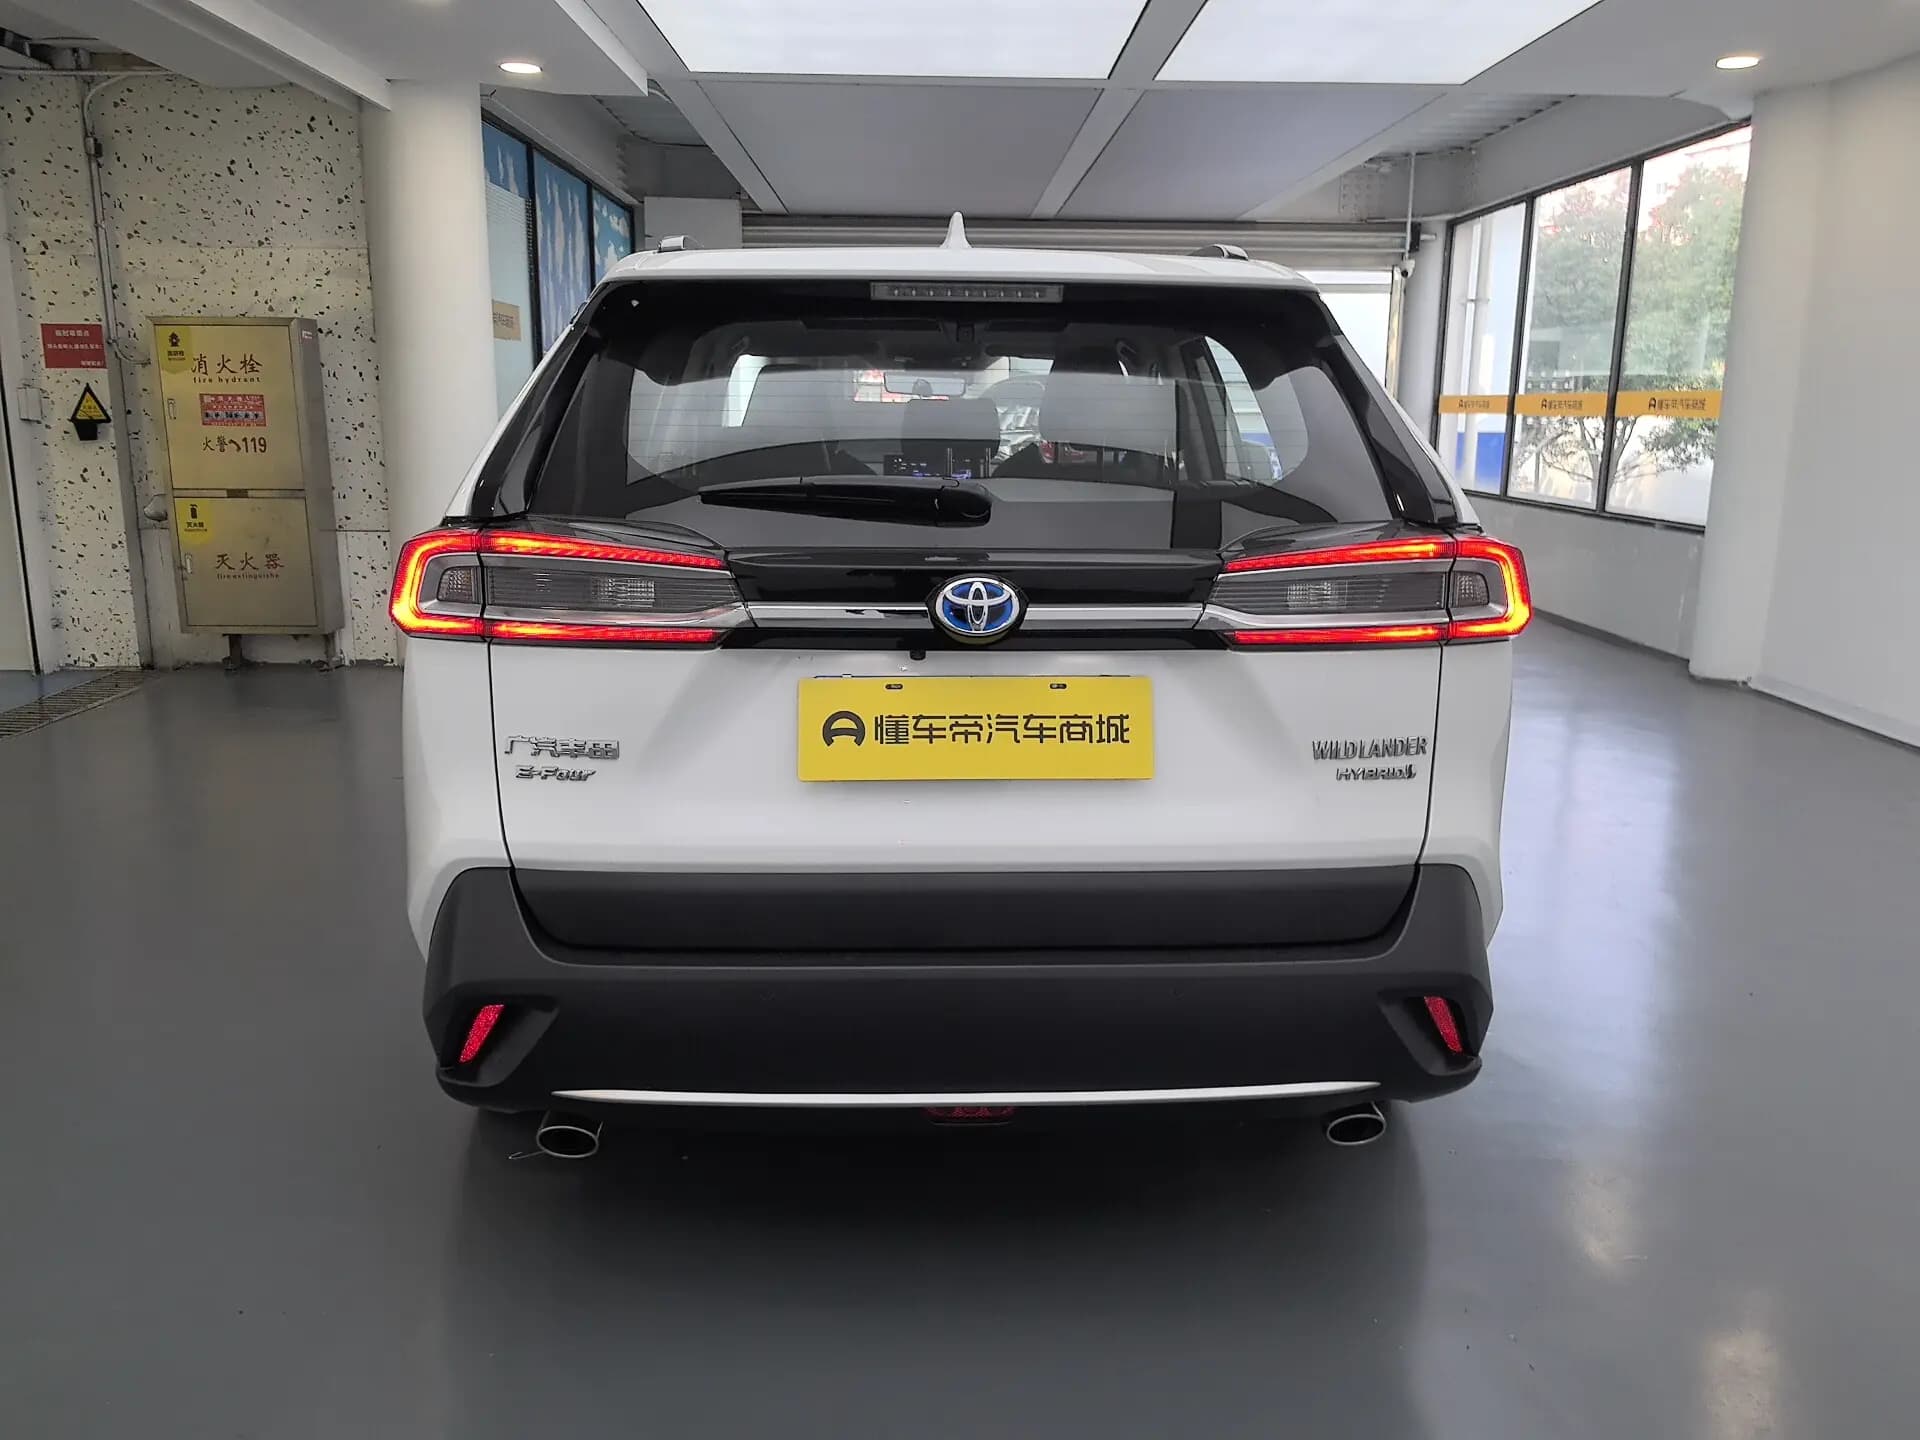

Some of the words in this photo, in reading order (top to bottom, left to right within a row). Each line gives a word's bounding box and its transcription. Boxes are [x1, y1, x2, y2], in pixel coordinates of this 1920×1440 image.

[191, 353, 263, 376] 消火栓
[193, 376, 213, 384] fire
[242, 436, 267, 453] 119
[215, 551, 285, 571] 灭火器
[874, 713, 1130, 745] 懂车帝汽车商城
